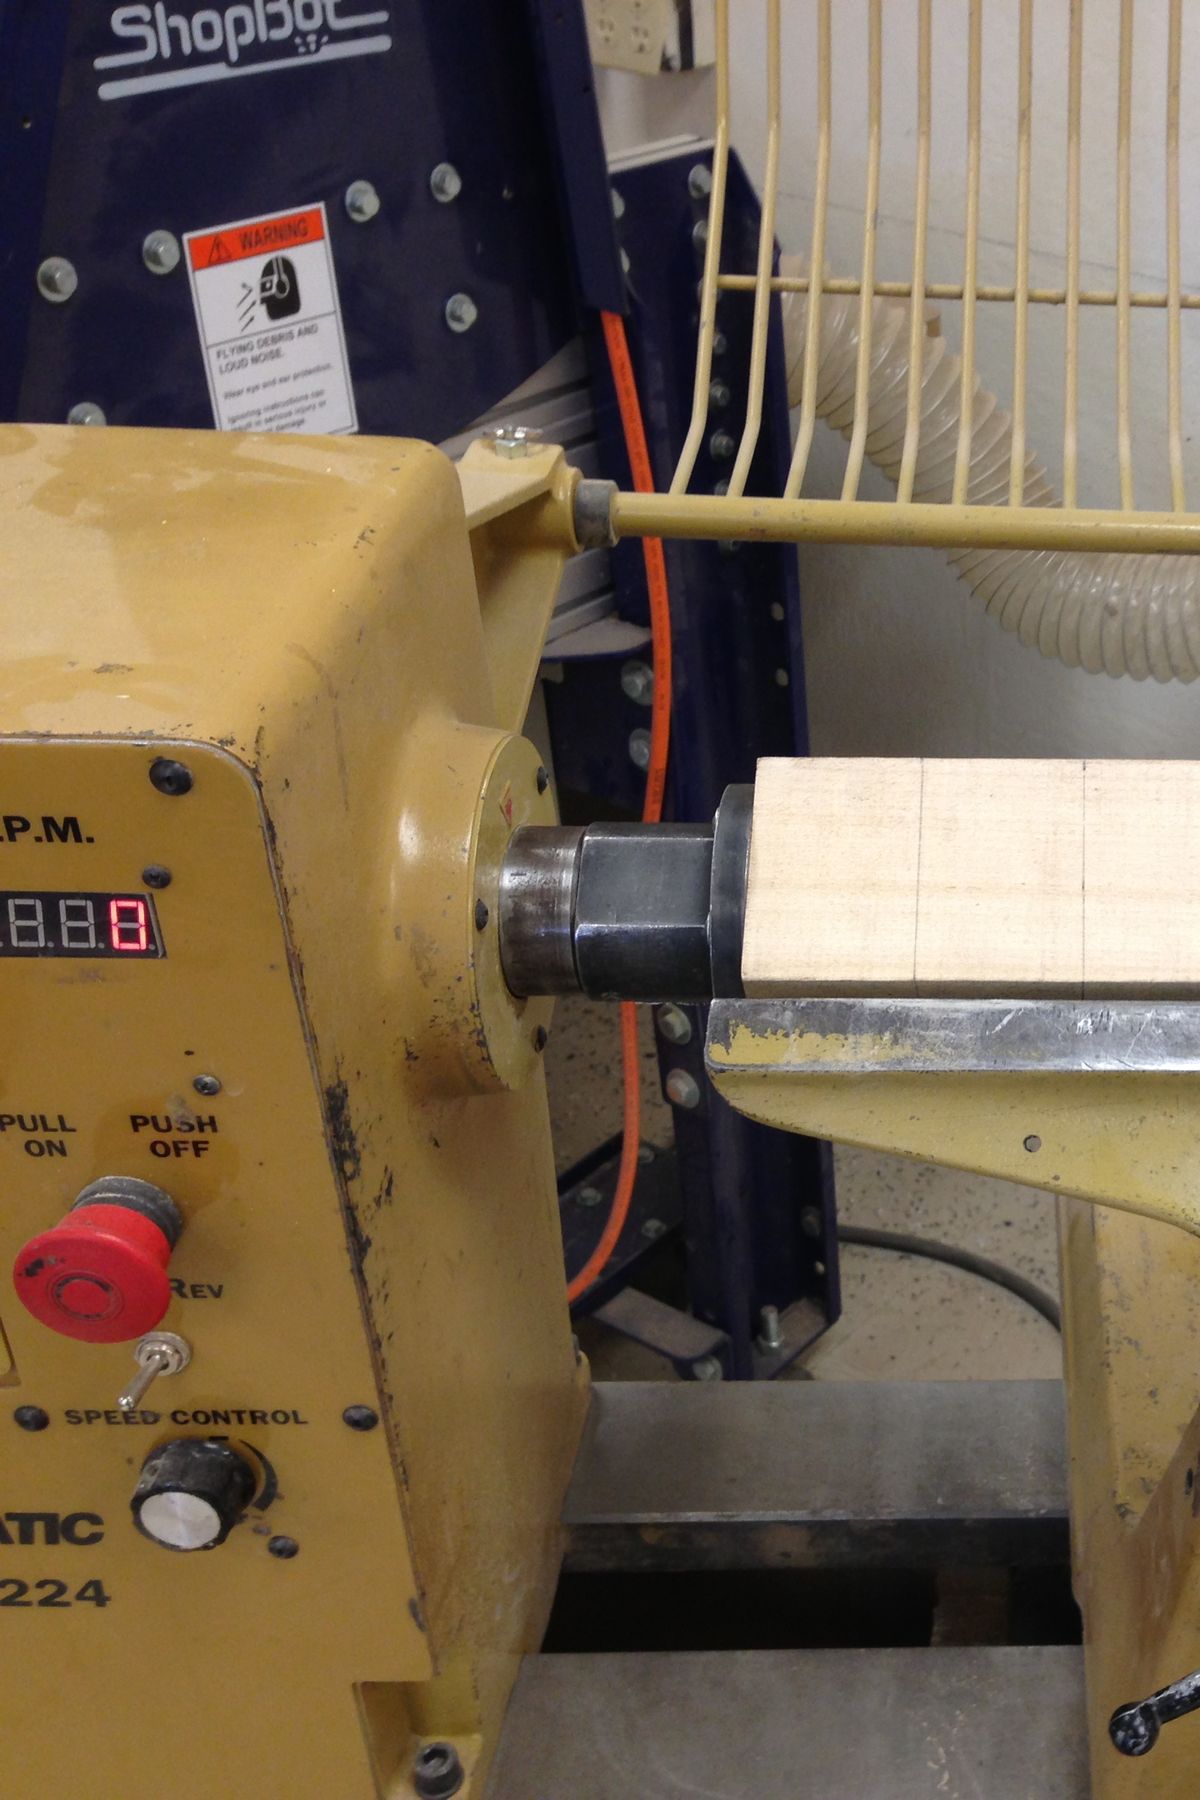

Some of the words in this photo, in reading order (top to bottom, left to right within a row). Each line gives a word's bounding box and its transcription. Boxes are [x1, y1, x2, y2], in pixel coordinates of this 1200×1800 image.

[94, 0, 390, 70] ShopBot
[239, 218, 308, 251] WARNING
[216, 340, 254, 360] FLYING
[256, 329, 295, 350] DEBRIS
[297, 323, 318, 337] AND
[219, 357, 249, 375] LOUD
[262, 377, 277, 389] and
[0, 1114, 76, 1133] PULL
[130, 1115, 218, 1133] PUSH
[24, 1140, 68, 1157] ON
[150, 1141, 209, 1158] OFF
[65, 1409, 161, 1425] SPEED
[171, 1410, 309, 1426] CONTROL
[0, 1579, 111, 1607] 224
